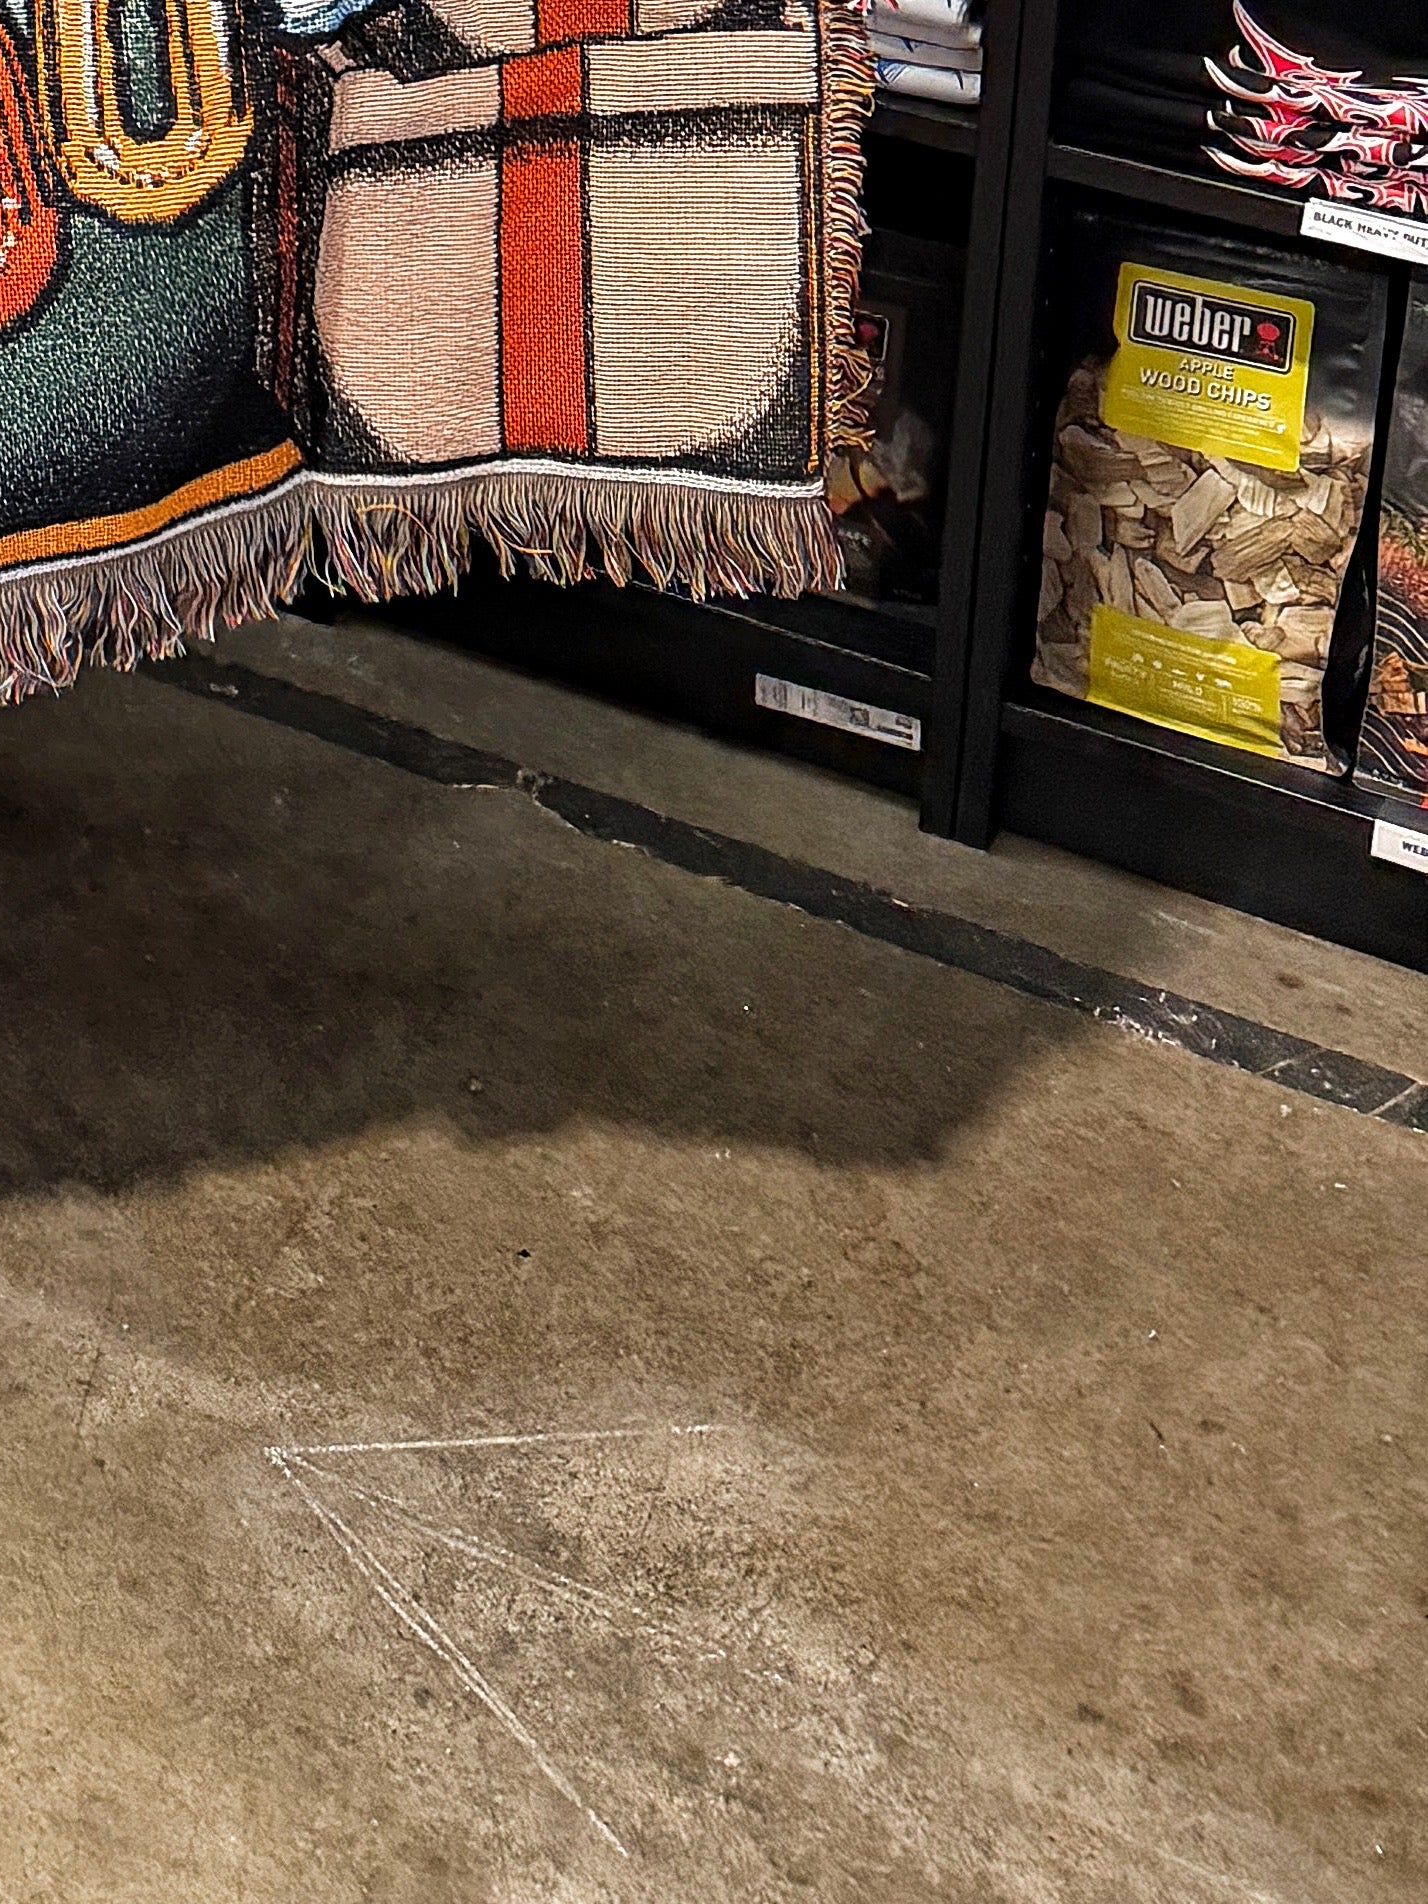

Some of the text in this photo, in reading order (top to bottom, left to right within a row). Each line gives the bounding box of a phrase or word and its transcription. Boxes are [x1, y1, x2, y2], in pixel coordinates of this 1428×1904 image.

[1314, 212, 1352, 229] BLACK
[1145, 294, 1251, 353] weber
[1179, 358, 1235, 381] APPLE
[1140, 367, 1272, 410] WOOD CHIPS
